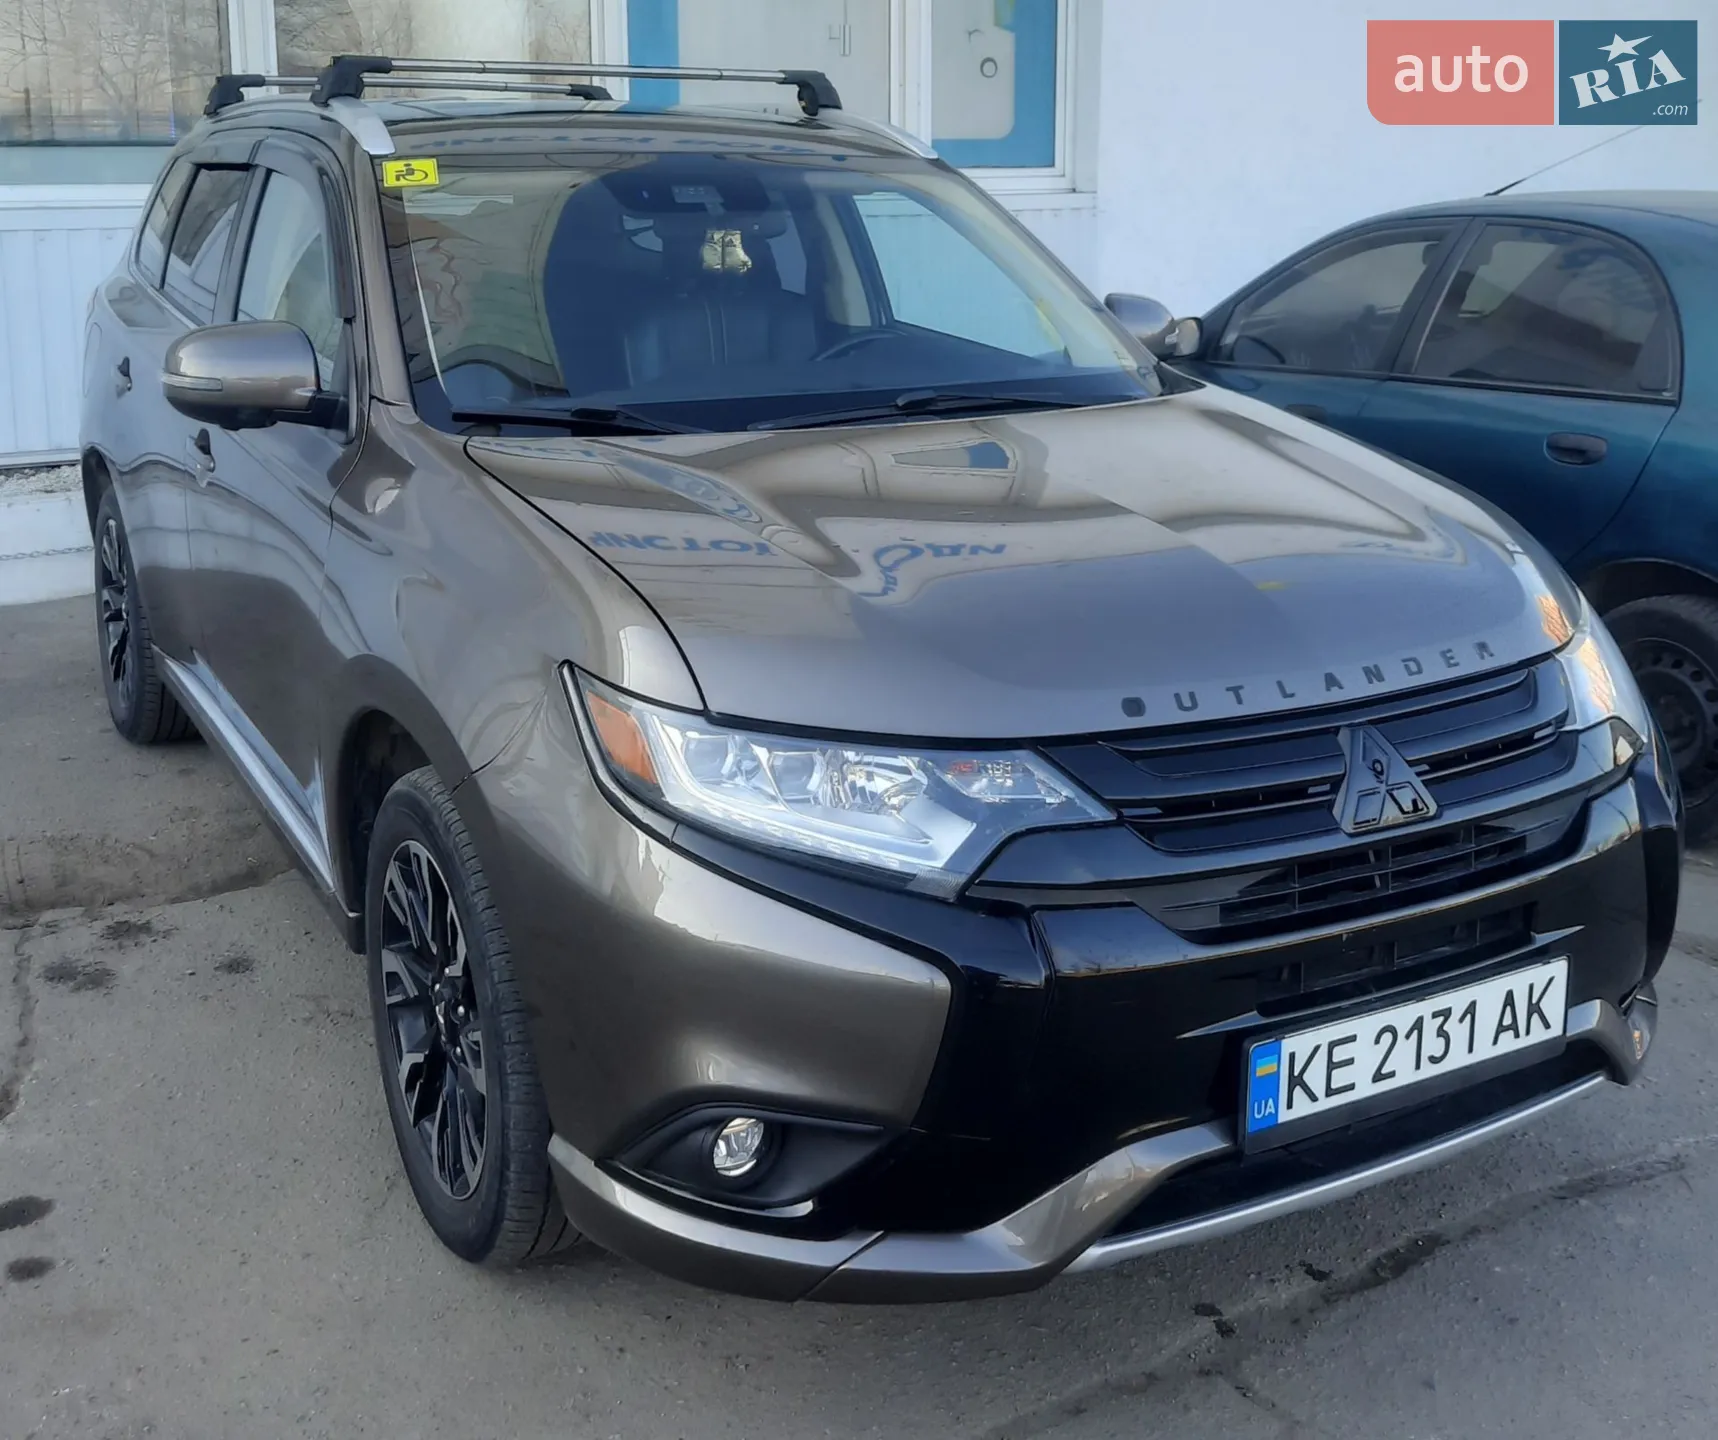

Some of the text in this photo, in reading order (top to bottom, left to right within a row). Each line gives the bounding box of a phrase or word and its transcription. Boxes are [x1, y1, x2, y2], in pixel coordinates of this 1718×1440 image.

[1120, 640, 1496, 718] OUTLANDER
[1285, 975, 1556, 1111] KE 2131 AK
[1253, 1096, 1277, 1120] UA
